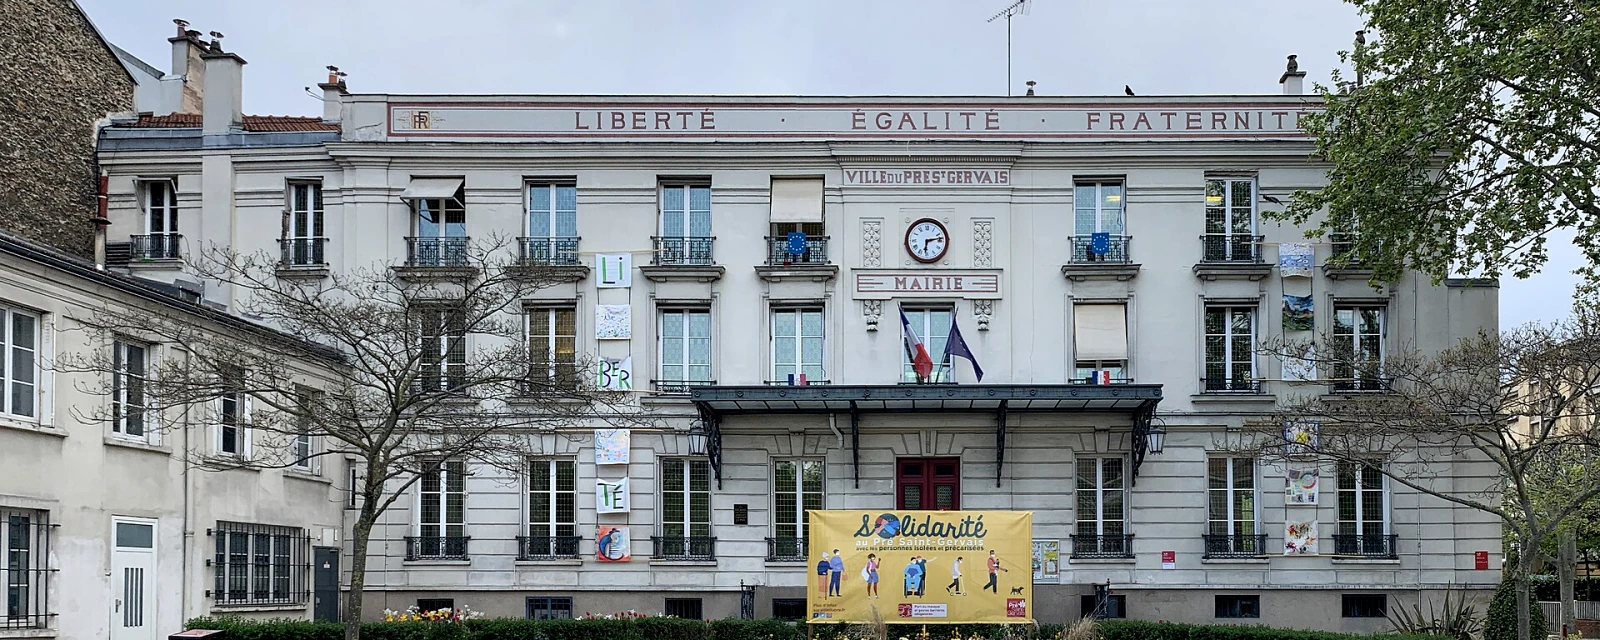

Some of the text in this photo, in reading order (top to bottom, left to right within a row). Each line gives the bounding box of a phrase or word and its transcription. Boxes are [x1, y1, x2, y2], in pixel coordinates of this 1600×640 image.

[575, 108, 715, 130] LIBERTÉ
[851, 108, 1000, 130] ÉGALITÉ
[845, 170, 886, 184] VILLE
[887, 173, 902, 184] DU
[947, 170, 1008, 184] GERVAIS
[894, 277, 963, 290] MAIRIE
[598, 360, 631, 388] BER
[597, 483, 624, 509] TÉ
[853, 513, 987, 539] Solidarité
[873, 537, 894, 546] Pré
[899, 537, 984, 546] Saint-Gervais
